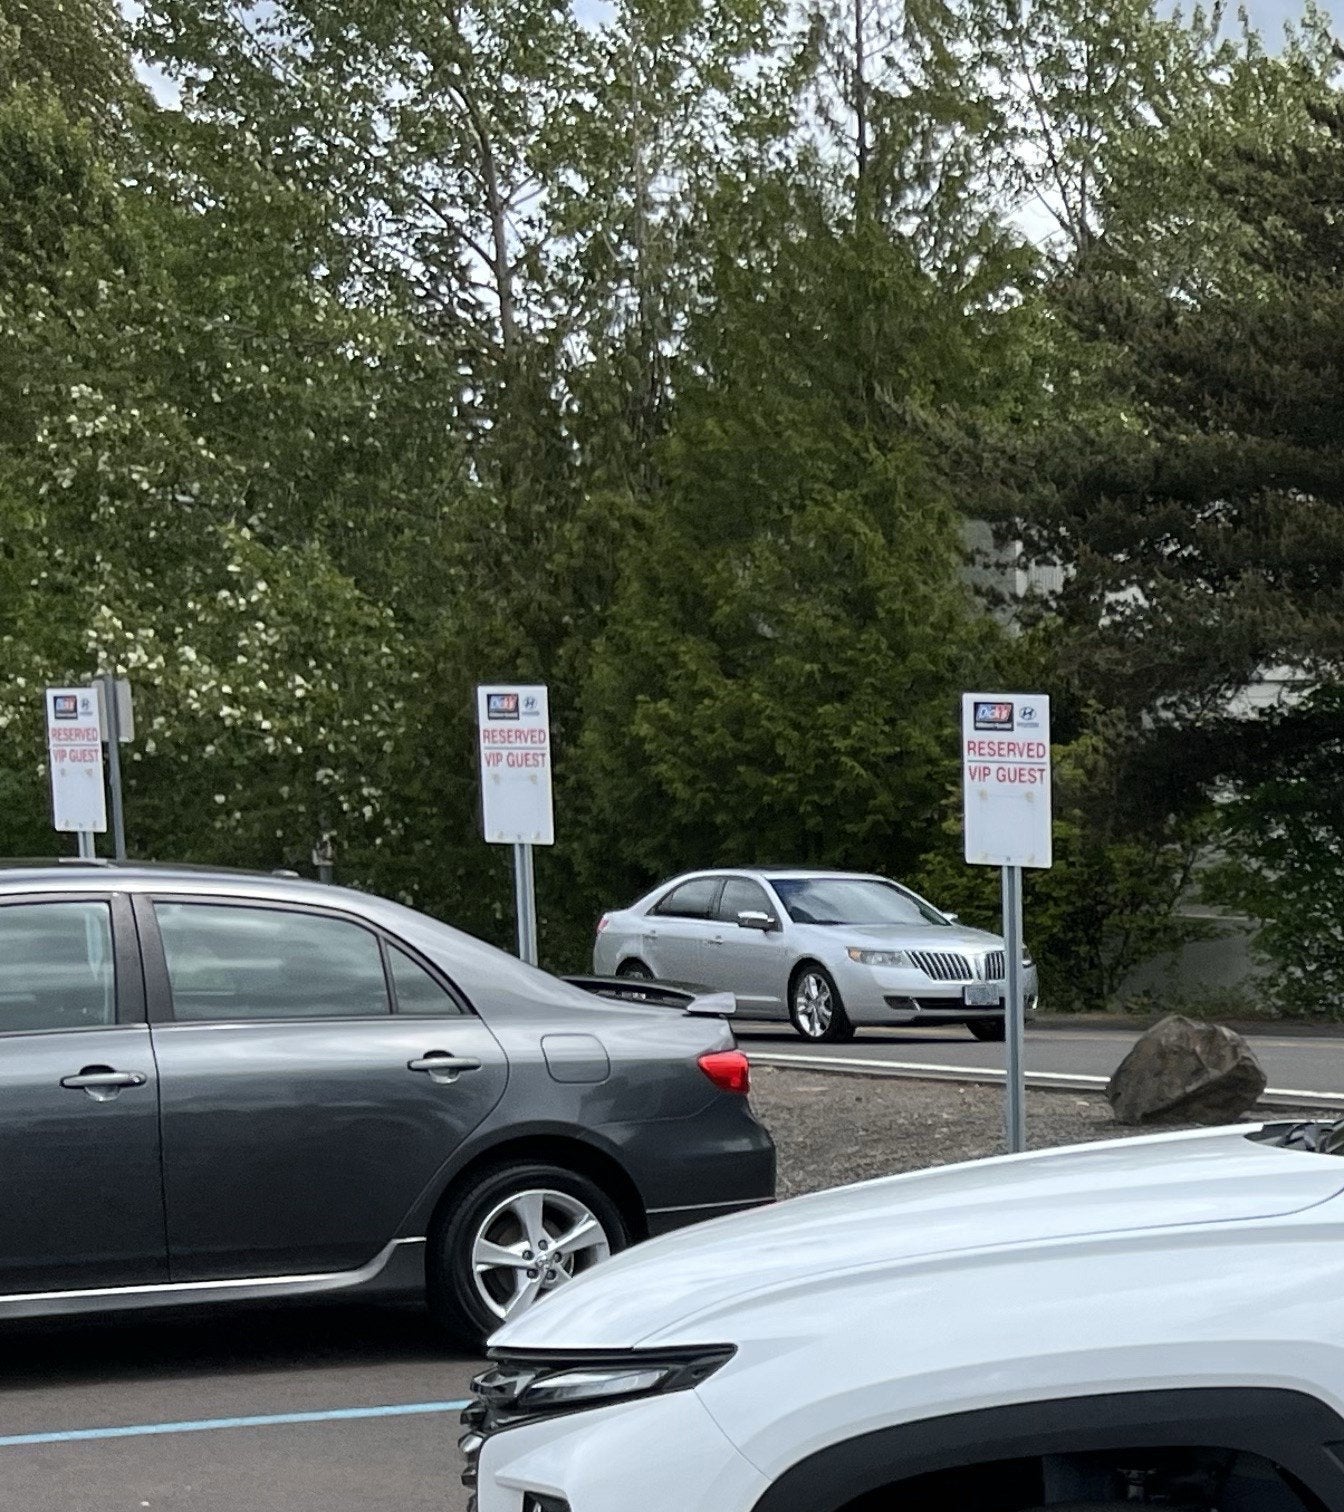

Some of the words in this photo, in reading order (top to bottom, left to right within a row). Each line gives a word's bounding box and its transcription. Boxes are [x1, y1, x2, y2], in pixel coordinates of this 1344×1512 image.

[51, 727, 98, 742] RESERVED
[482, 728, 546, 745] RESERVED
[967, 740, 1046, 759] RESERVED
[484, 752, 503, 768] VIP
[506, 752, 546, 768] GUEST
[968, 766, 991, 783] VIP
[996, 766, 1046, 784] GUEST
